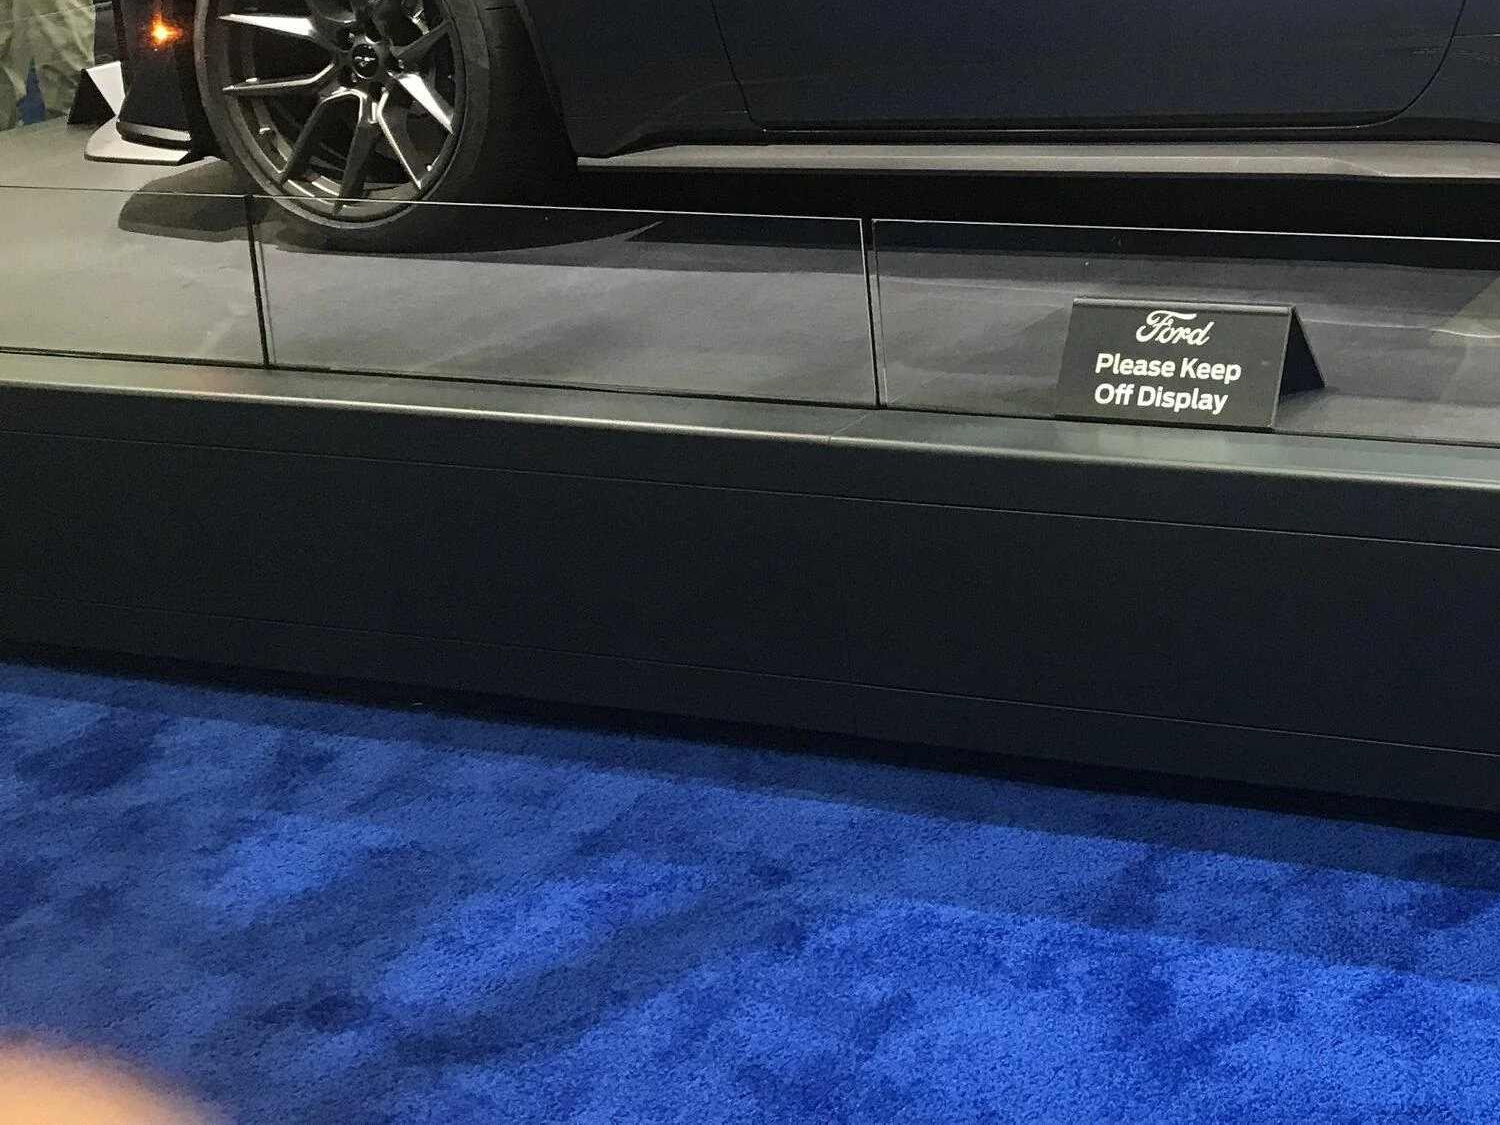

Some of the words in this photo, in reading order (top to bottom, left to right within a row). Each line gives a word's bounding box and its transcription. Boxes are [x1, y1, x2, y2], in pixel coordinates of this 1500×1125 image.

[1135, 310, 1215, 345] Ford
[1095, 353, 1176, 378] Please
[1180, 357, 1242, 384] Keep
[1094, 383, 1136, 405] Off
[1137, 386, 1229, 415] Display
